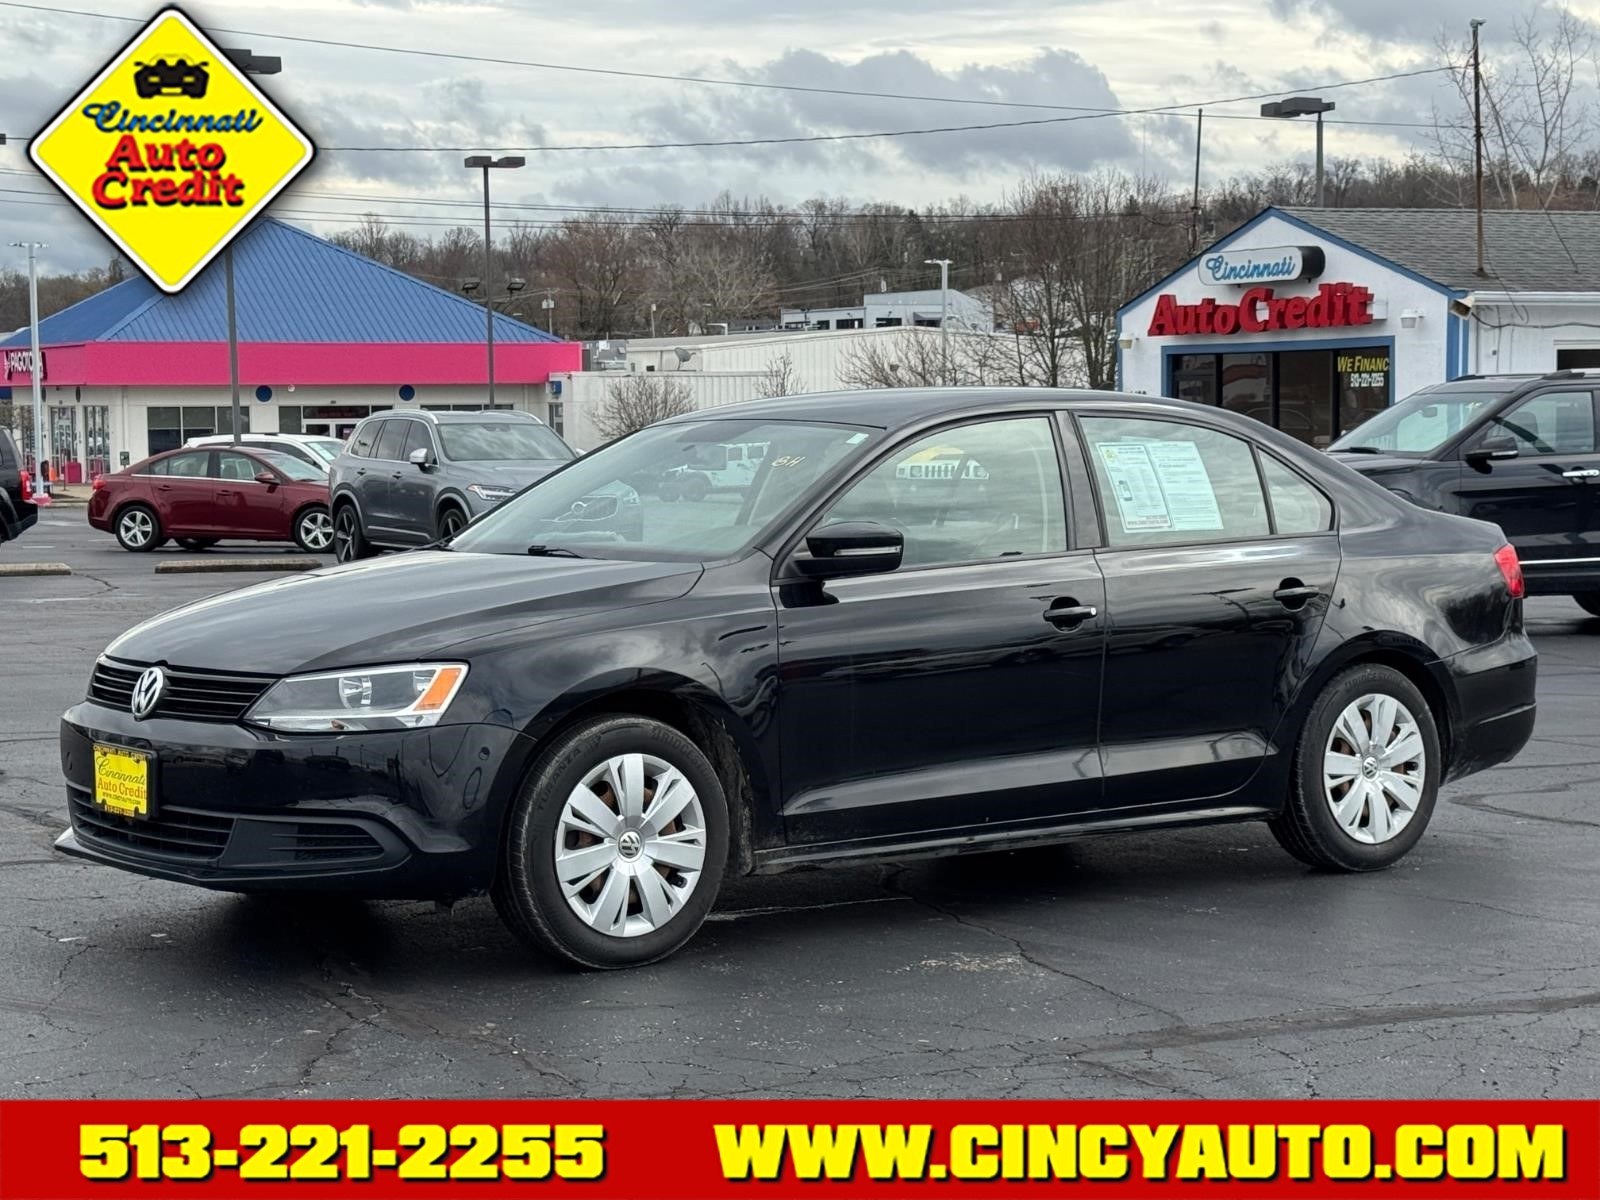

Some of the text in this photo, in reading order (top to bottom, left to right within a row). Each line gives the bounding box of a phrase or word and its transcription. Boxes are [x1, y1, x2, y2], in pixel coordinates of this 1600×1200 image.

[1205, 254, 1296, 281] Cincinnati
[1337, 355, 1354, 373] WE
[97, 778, 118, 793] Auto
